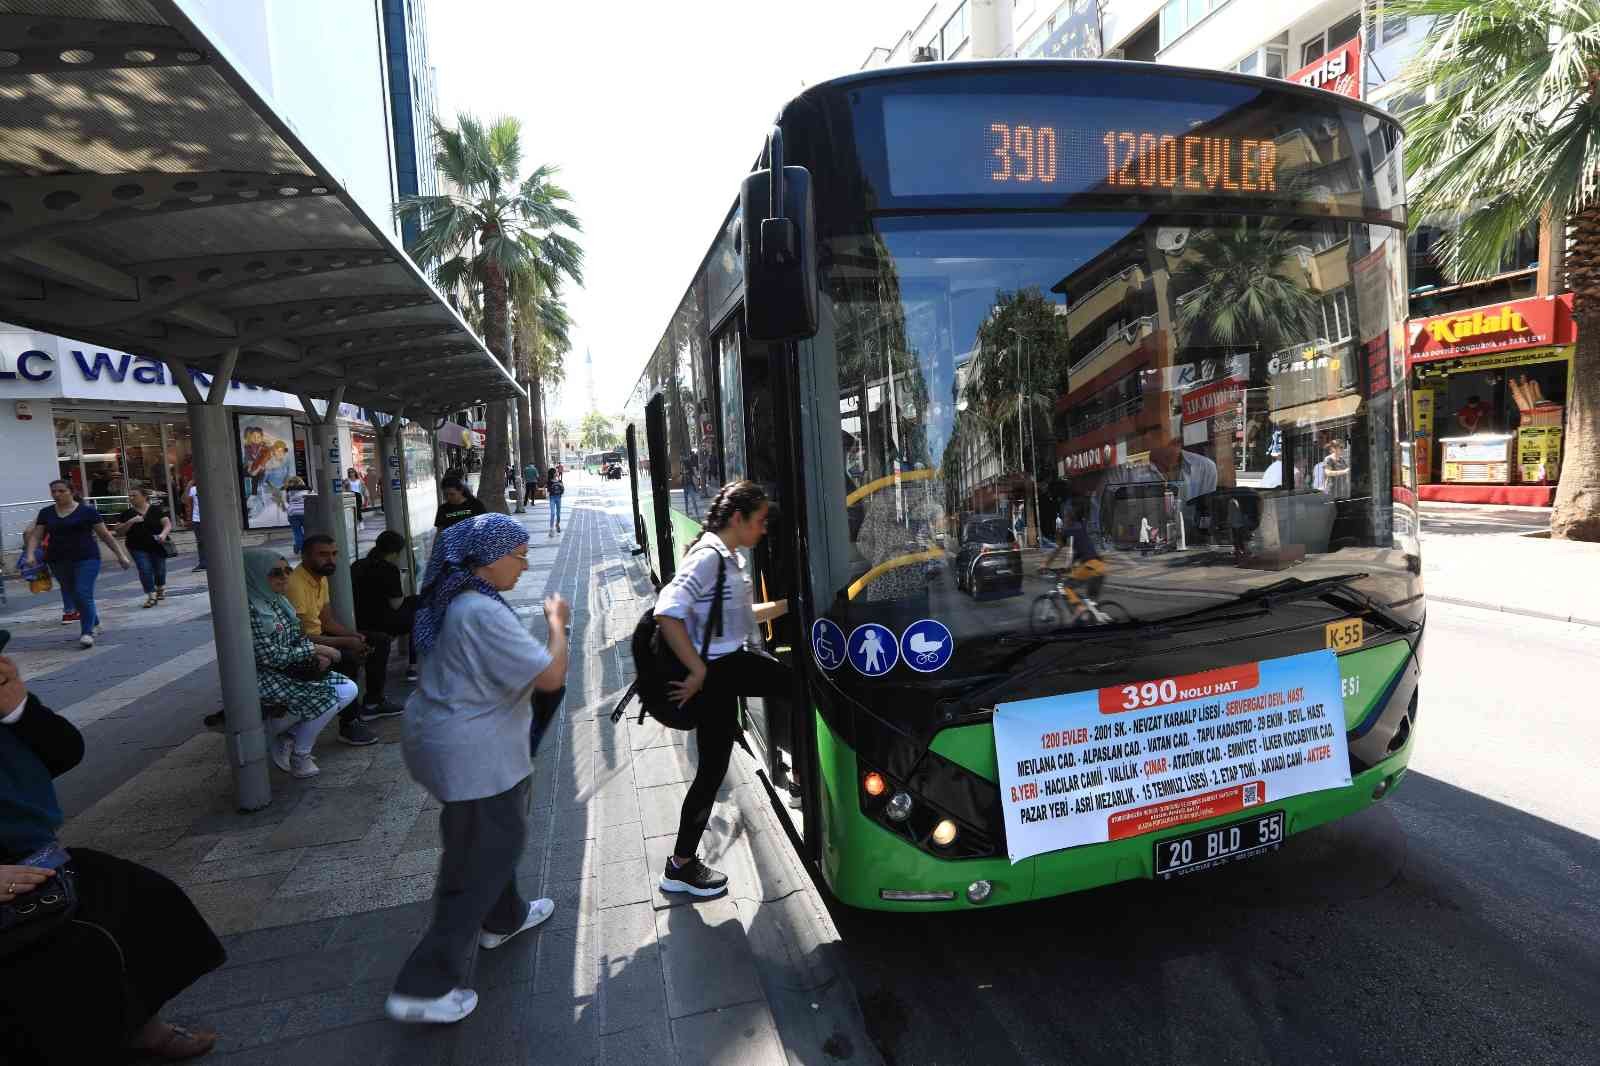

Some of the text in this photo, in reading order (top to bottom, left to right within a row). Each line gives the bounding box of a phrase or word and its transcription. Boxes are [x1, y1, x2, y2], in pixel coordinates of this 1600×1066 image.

[991, 121, 1056, 183] 390
[1428, 306, 1529, 343] Külah
[0, 350, 53, 382] C
[1330, 624, 1360, 648] K-55
[1040, 732, 1061, 750] 1200
[1062, 727, 1089, 747] EVLER
[1094, 725, 1113, 741] 2001
[1114, 722, 1128, 736] SK.
[1132, 713, 1163, 734] NEVZAT
[1163, 709, 1197, 728] KARAALP
[1198, 702, 1221, 721] LİSESİ
[1226, 697, 1267, 717] SERVERGAZİ
[1287, 687, 1305, 705] HAST.
[1121, 679, 1238, 710] 390 NOLU HAT
[1011, 779, 1039, 803] B.YERİ
[1044, 775, 1079, 797] HACILAR
[1108, 759, 1139, 784] VALİLİK
[1144, 757, 1168, 781] ÇINAR
[1172, 749, 1205, 770] ATATÜRK
[1206, 746, 1223, 763] CAD.
[1227, 736, 1258, 759] EMNİYET
[1262, 731, 1283, 752] İLKER
[1283, 725, 1320, 747] KOCABIYIK
[1320, 723, 1335, 739] CAD.
[1017, 755, 1057, 777] MEVLANA
[1057, 752, 1077, 770] CAD.
[1082, 744, 1123, 765] ALPASLAN
[1124, 740, 1142, 757] CAD.
[1147, 735, 1172, 753] VATAN
[1173, 731, 1190, 748] CAD.
[1197, 725, 1215, 744] TAPU
[1216, 719, 1252, 740] KADASTRO
[1257, 716, 1266, 731] 29
[1266, 710, 1283, 730] EKİM
[1307, 703, 1326, 720] HAST.
[1020, 806, 1048, 824] PAZAR
[1049, 796, 1069, 818] YERİ
[1075, 791, 1094, 814] ASRİ
[1095, 787, 1136, 810] MEZARLIK
[1142, 785, 1152, 801] 15
[1153, 777, 1185, 799] TEMMUZ
[1186, 767, 1208, 791] LİSESİ
[1212, 770, 1221, 786] 2.
[1220, 765, 1239, 784] ETAP
[1239, 759, 1256, 779] TOKİ
[1307, 744, 1331, 764] AKTEPE
[1169, 840, 1193, 867] 20
[1207, 827, 1241, 858] BLD
[1259, 816, 1280, 843] 55
